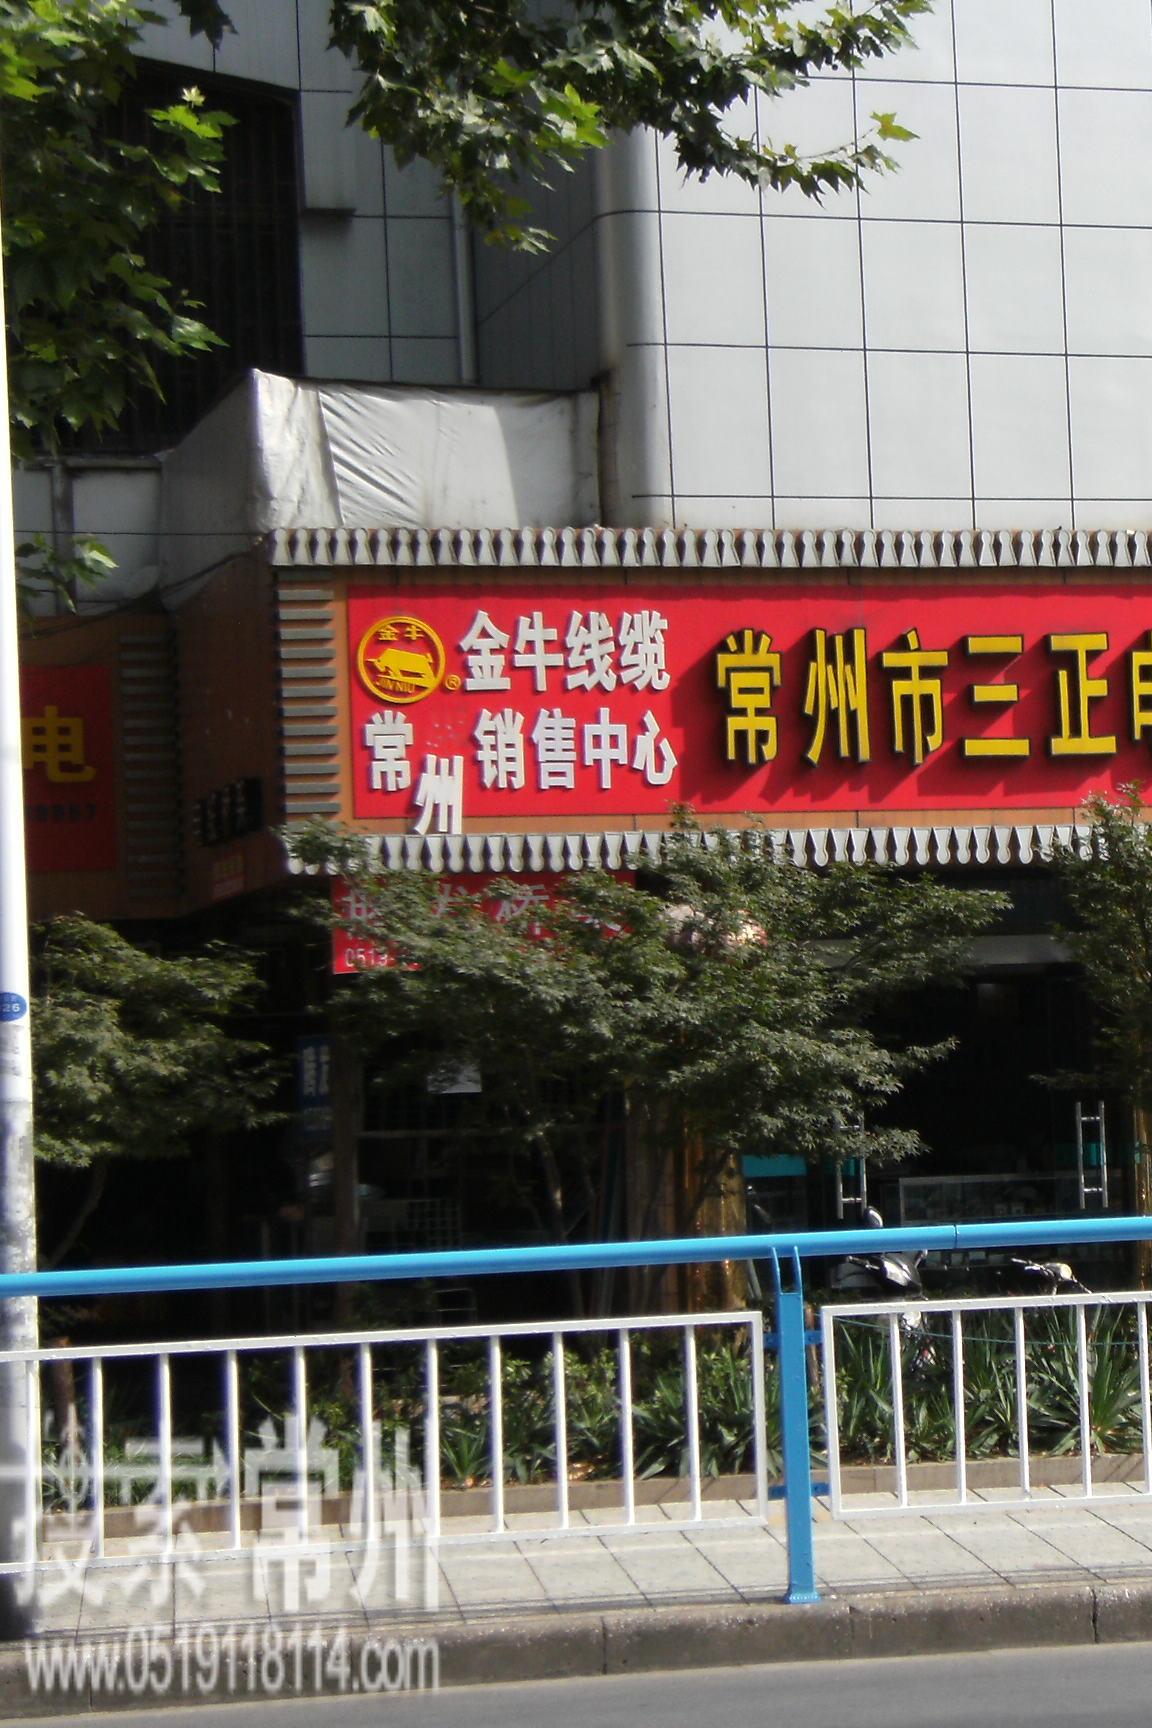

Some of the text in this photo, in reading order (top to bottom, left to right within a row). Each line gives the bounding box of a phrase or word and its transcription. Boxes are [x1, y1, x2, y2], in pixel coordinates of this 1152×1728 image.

[378, 625, 424, 641] 金牛
[459, 610, 671, 693] 金牛线缆
[474, 708, 679, 790] 销售中心
